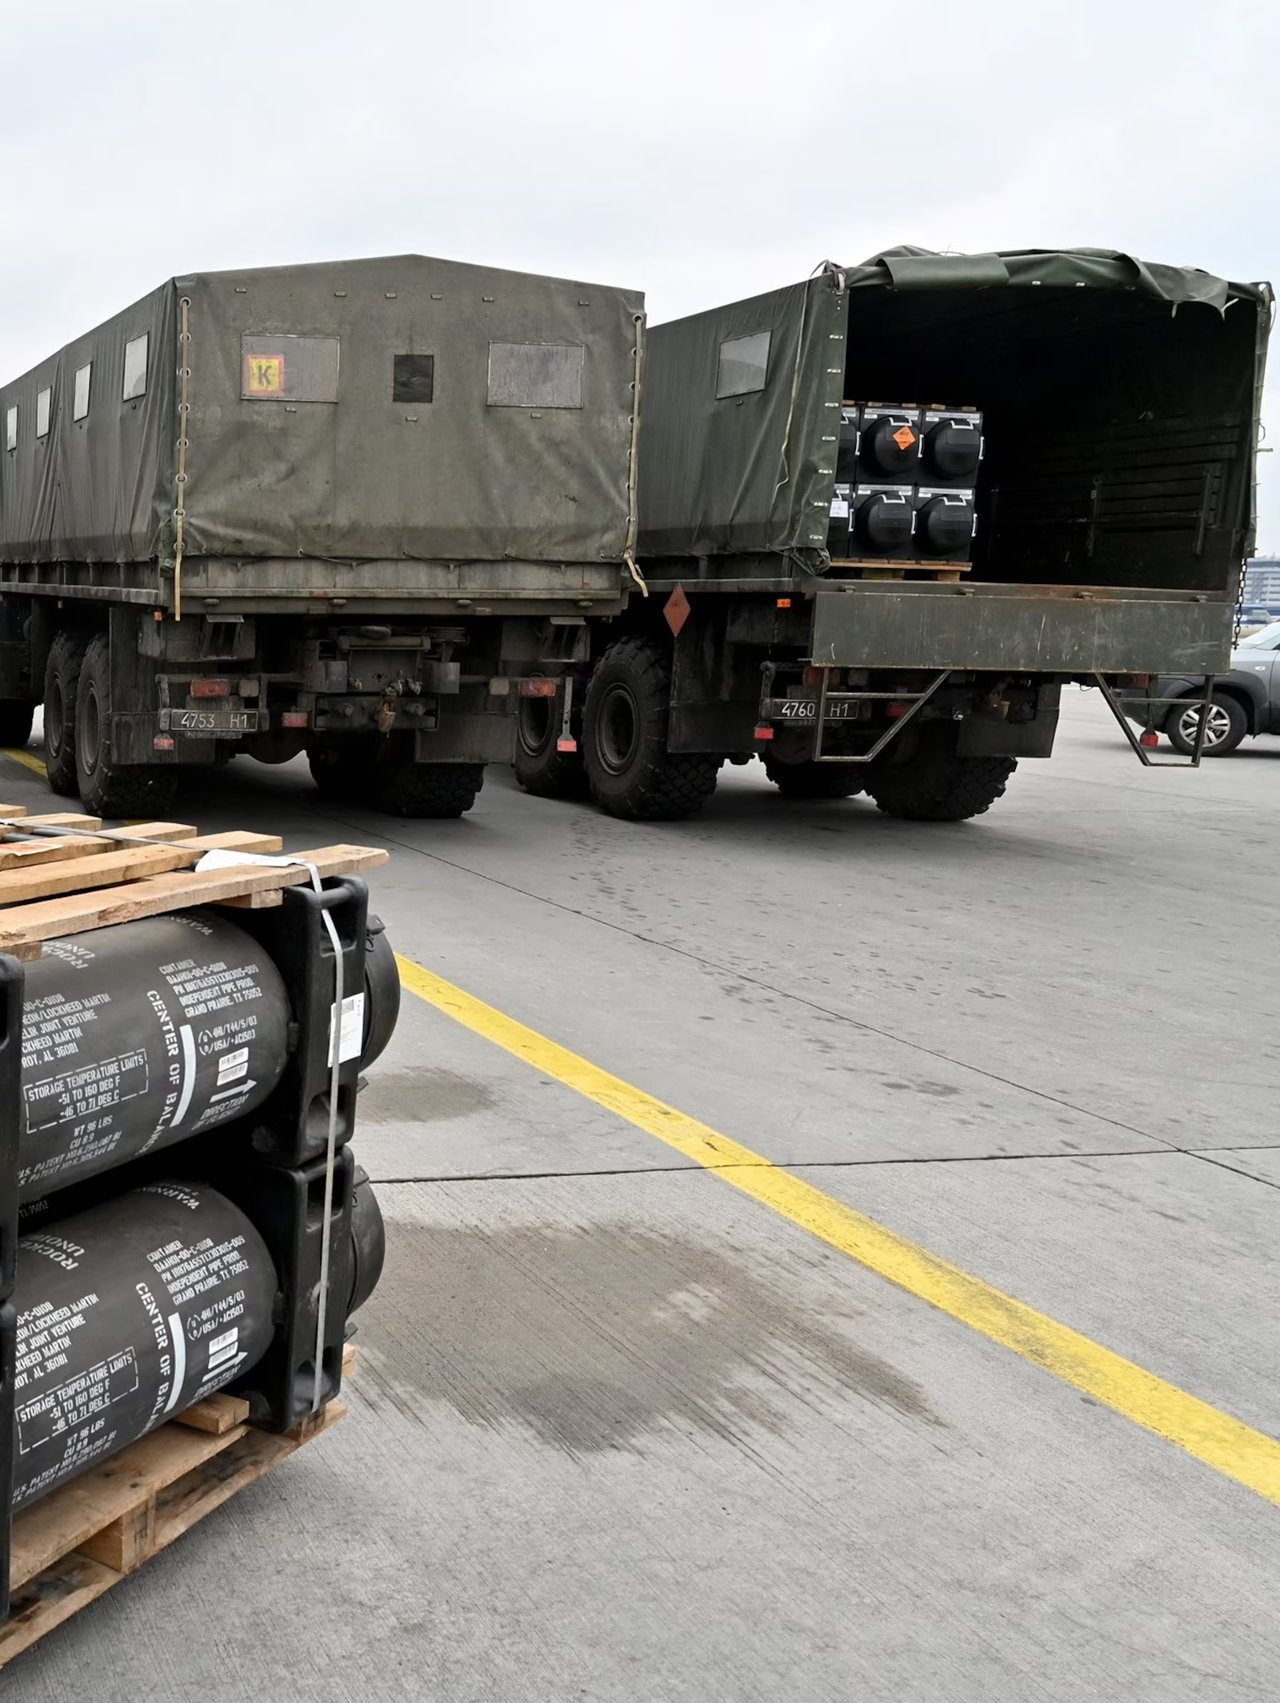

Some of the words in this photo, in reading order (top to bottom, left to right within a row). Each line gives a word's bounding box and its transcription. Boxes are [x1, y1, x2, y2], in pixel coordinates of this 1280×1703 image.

[258, 365, 272, 385] K
[181, 713, 216, 728] 4753
[230, 714, 248, 728] H1
[781, 702, 816, 717] 4760
[830, 703, 849, 717] H1
[158, 959, 197, 975] CONTAINER
[82, 993, 112, 1009] MARTIN
[179, 985, 221, 1006] INDEPENDENT
[220, 982, 237, 994] PIPE
[184, 1003, 208, 1018] GRAND
[232, 993, 243, 1004] TX
[243, 987, 263, 1000] 75052
[40, 1018, 61, 1034] JOINT
[62, 1009, 98, 1027] VENTURE
[53, 1026, 83, 1044] MARTIN
[147, 990, 179, 1058] CENTER
[169, 1063, 180, 1085] OF
[43, 1051, 55, 1063] AL
[55, 1042, 79, 1058] 36081
[28, 1080, 65, 1101] STORAGE
[66, 1062, 120, 1089] TEMPERATURE
[121, 1055, 145, 1071] LIMITS
[58, 1093, 70, 1105] -51
[72, 1089, 84, 1102] TO
[85, 1085, 98, 1099] 160
[99, 1079, 113, 1093] DEG
[115, 1075, 121, 1087] F
[60, 1105, 74, 1117] -46
[76, 1100, 87, 1113] TO
[88, 1098, 97, 1110] 71
[98, 1094, 112, 1107] DEG
[114, 1090, 120, 1101] C
[73, 1124, 86, 1137] WT
[86, 1121, 97, 1132] 96
[98, 1115, 114, 1129] LBS
[70, 1138, 82, 1150] CU
[33, 1154, 65, 1174] PATENT
[146, 1240, 184, 1263] CONTAINER
[167, 1266, 209, 1295] INDEPENDENT
[208, 1258, 225, 1274] PIPE
[172, 1287, 195, 1306] GRAND
[220, 1268, 231, 1280] TX
[229, 1259, 249, 1277] 75052
[70, 1293, 99, 1314] MARTIN
[29, 1331, 51, 1350] JOINT
[51, 1313, 87, 1338] VENTURE
[135, 1282, 169, 1350] CENTER
[159, 1354, 171, 1377] OF
[42, 1335, 72, 1359] MARTIN
[33, 1365, 45, 1380] AL
[44, 1352, 68, 1373] 36081
[20, 1394, 57, 1422] STORAGE
[57, 1364, 110, 1402] TEMPERATURE
[109, 1352, 133, 1374] LIMITS
[50, 1405, 62, 1419] -51
[63, 1399, 74, 1413] TO
[75, 1393, 88, 1409] 160
[89, 1382, 104, 1399] DEG
[105, 1377, 111, 1390] F
[52, 1416, 66, 1430] -46
[68, 1411, 78, 1424] TO
[79, 1406, 87, 1418] 71
[88, 1398, 103, 1413] DEG
[104, 1392, 111, 1404] C
[67, 1432, 79, 1447] WT
[79, 1426, 90, 1440] 96
[91, 1416, 106, 1433] LBS
[64, 1445, 76, 1459] CU
[29, 1463, 61, 1487] PATENT
